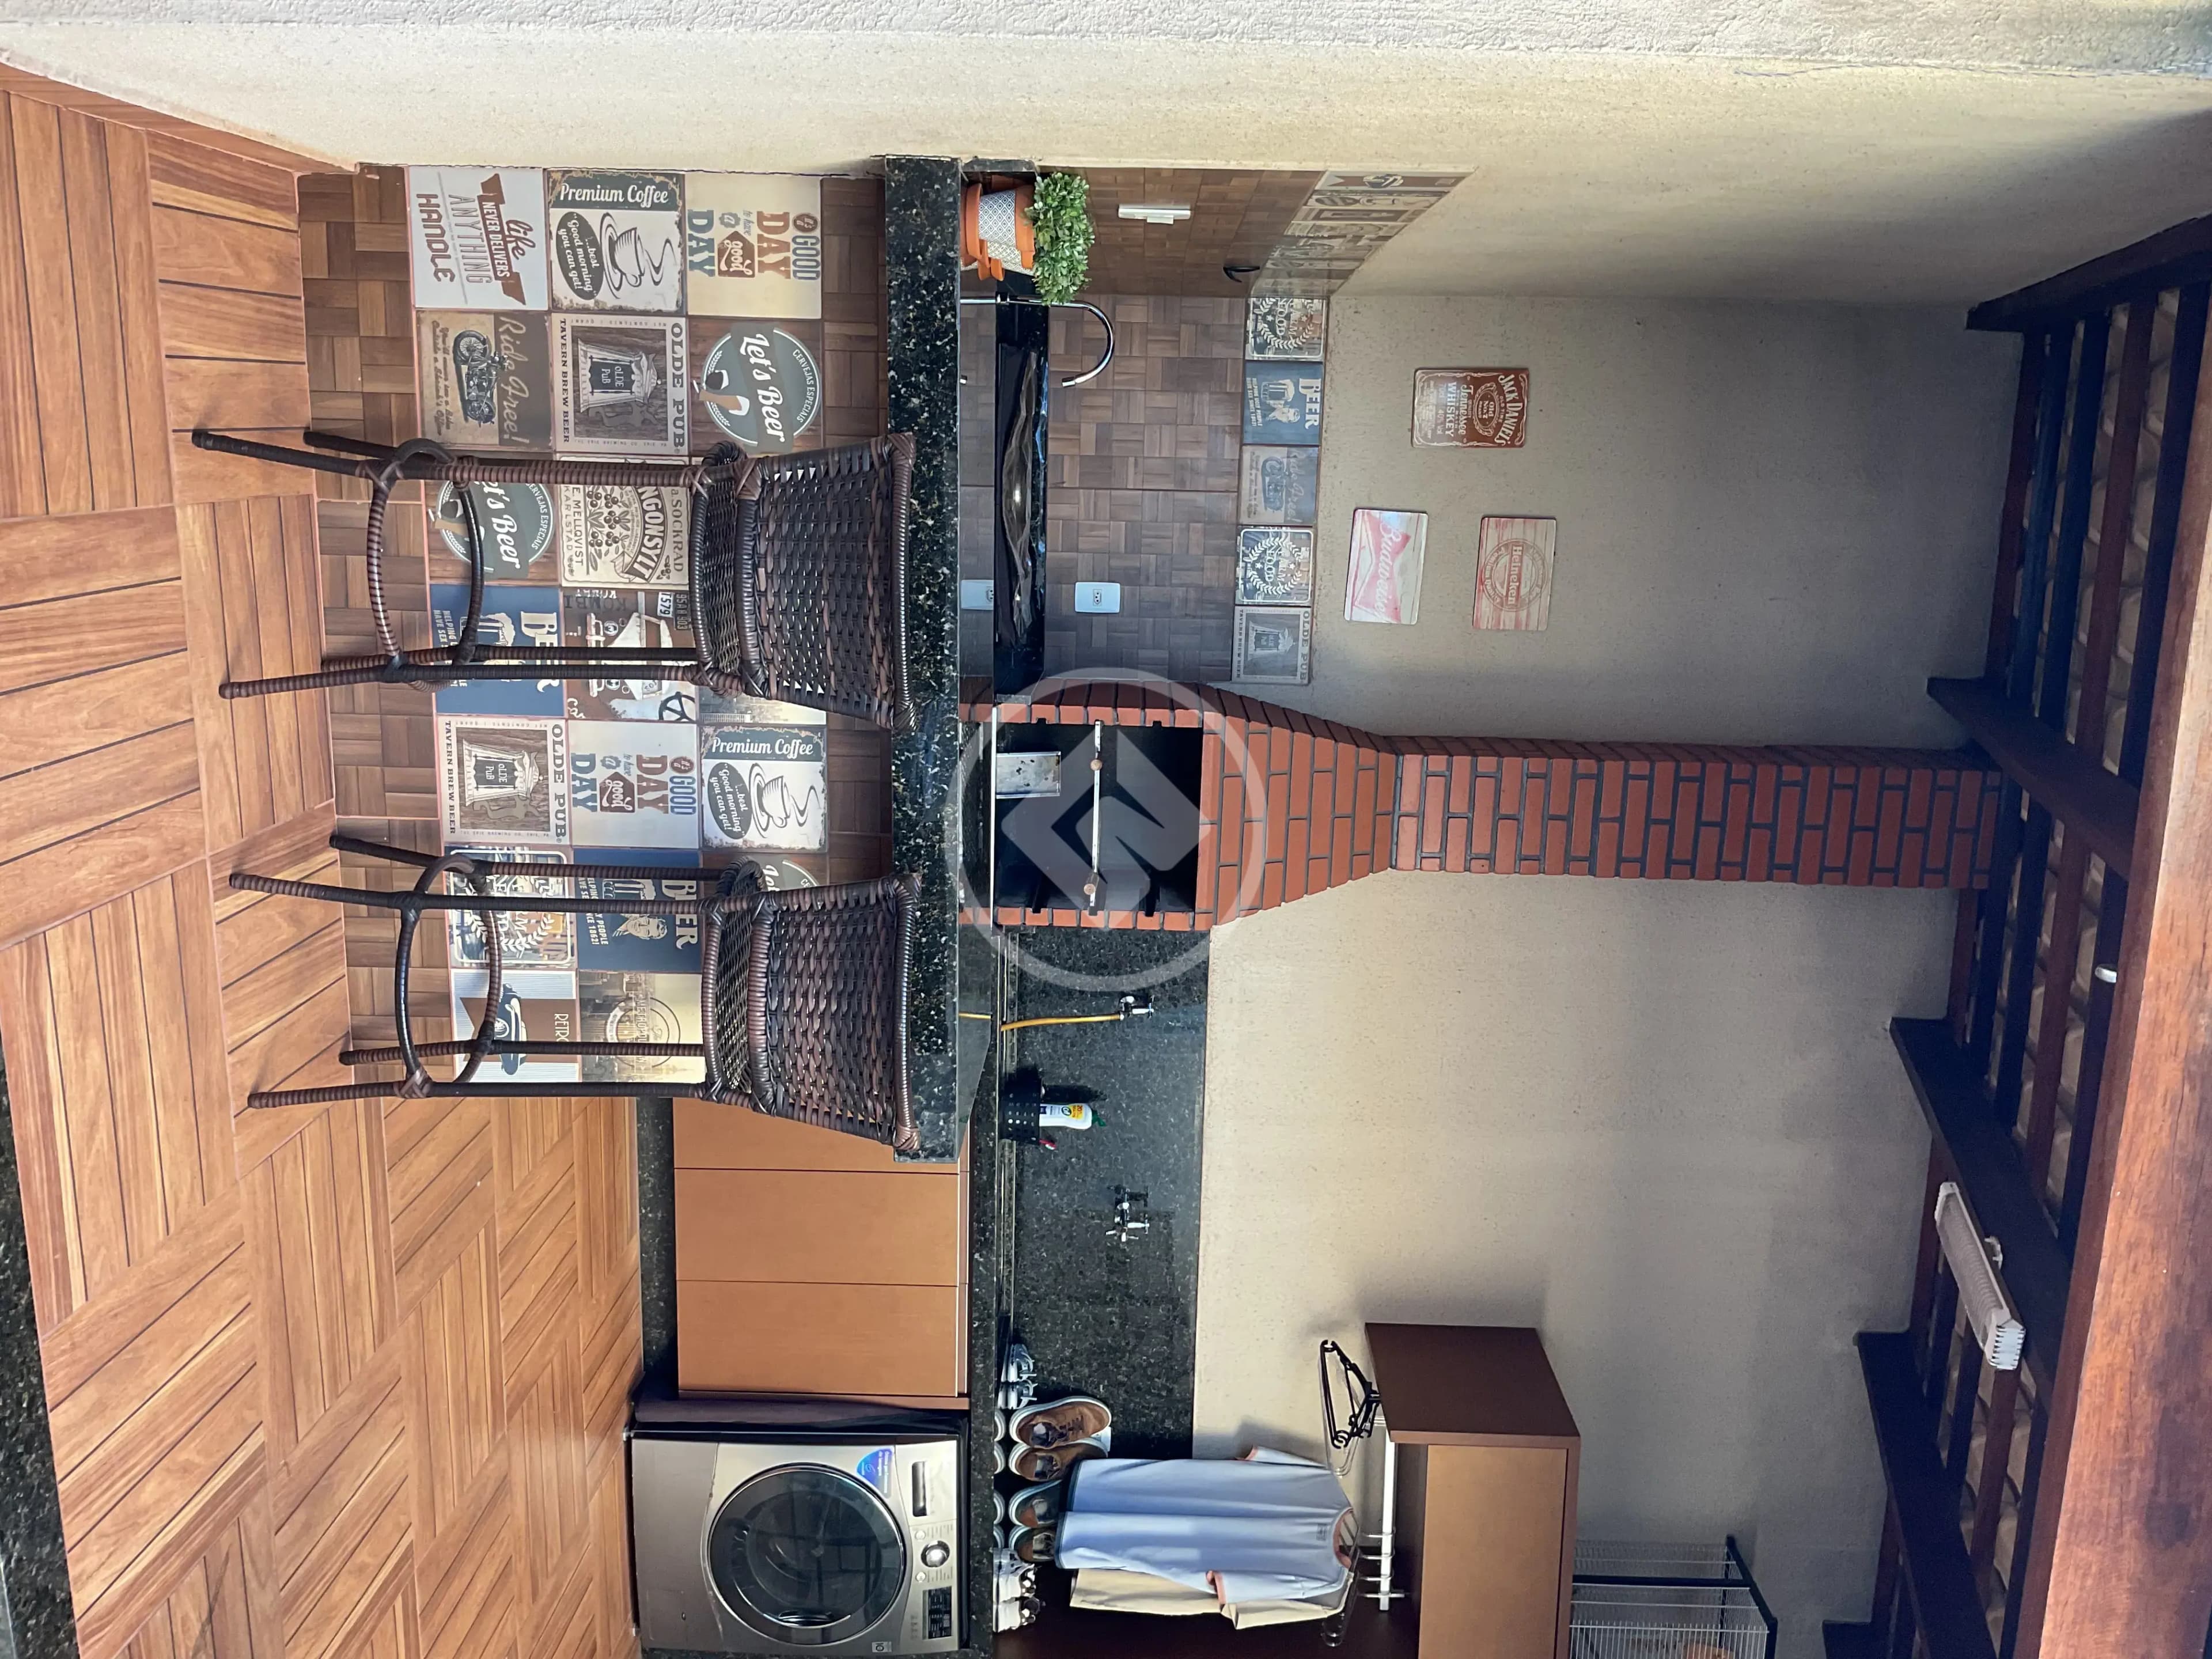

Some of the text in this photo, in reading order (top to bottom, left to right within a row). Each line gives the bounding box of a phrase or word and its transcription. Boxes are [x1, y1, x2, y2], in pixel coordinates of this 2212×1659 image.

[560, 183, 669, 208] Premium Coffee
[724, 215, 735, 224] a
[448, 194, 493, 283] ANYTHING
[482, 202, 510, 277] NEVER DELIVERS
[506, 220, 536, 260] life
[687, 210, 715, 277] DAY
[744, 219, 754, 237] have
[757, 211, 791, 279] DAY
[558, 229, 584, 289] you can get!
[719, 240, 752, 275] good
[792, 236, 820, 281] GOOD
[498, 317, 529, 444] Ride Free!
[672, 323, 684, 448] OLDE PUB
[740, 334, 785, 442] Let's Beer
[792, 349, 815, 422] CERVEJAS ESPECIAIS
[1298, 378, 1321, 429] BEER
[1445, 382, 1456, 437] WHISKEY
[1459, 385, 1474, 435] Tennessee
[1494, 374, 1522, 446] JACK DANIEL'S
[480, 482, 520, 569] et's Beer
[531, 515, 548, 550] ESPECIAIS
[564, 486, 573, 551] KARLSTAD
[573, 500, 583, 566] MELLQVIST
[633, 487, 664, 579] NGONSYLT
[672, 499, 683, 572] SOCKRAD
[1264, 551, 1275, 581] FOOD
[1374, 524, 1402, 622] Budweiser
[1484, 548, 1505, 604] Premium Quality
[1508, 546, 1522, 604] Heineken
[433, 610, 447, 642] HAVE SEX
[442, 610, 456, 639] HELPING
[1302, 611, 1310, 647] OLDE
[623, 762, 634, 777] have
[712, 737, 813, 759] Premium Coffee
[552, 724, 566, 838] OLDE PUB
[571, 753, 597, 812] DAY
[602, 779, 632, 810] good
[637, 755, 669, 814] DAY
[669, 776, 696, 815] GOOD
[710, 777, 733, 830] you can get!
[578, 877, 587, 888] AVE
[586, 913, 594, 923] NCE
[588, 878, 599, 899] ELPIN
[596, 921, 608, 944] PEOPLE
[636, 999, 647, 1062] METROPOLN
